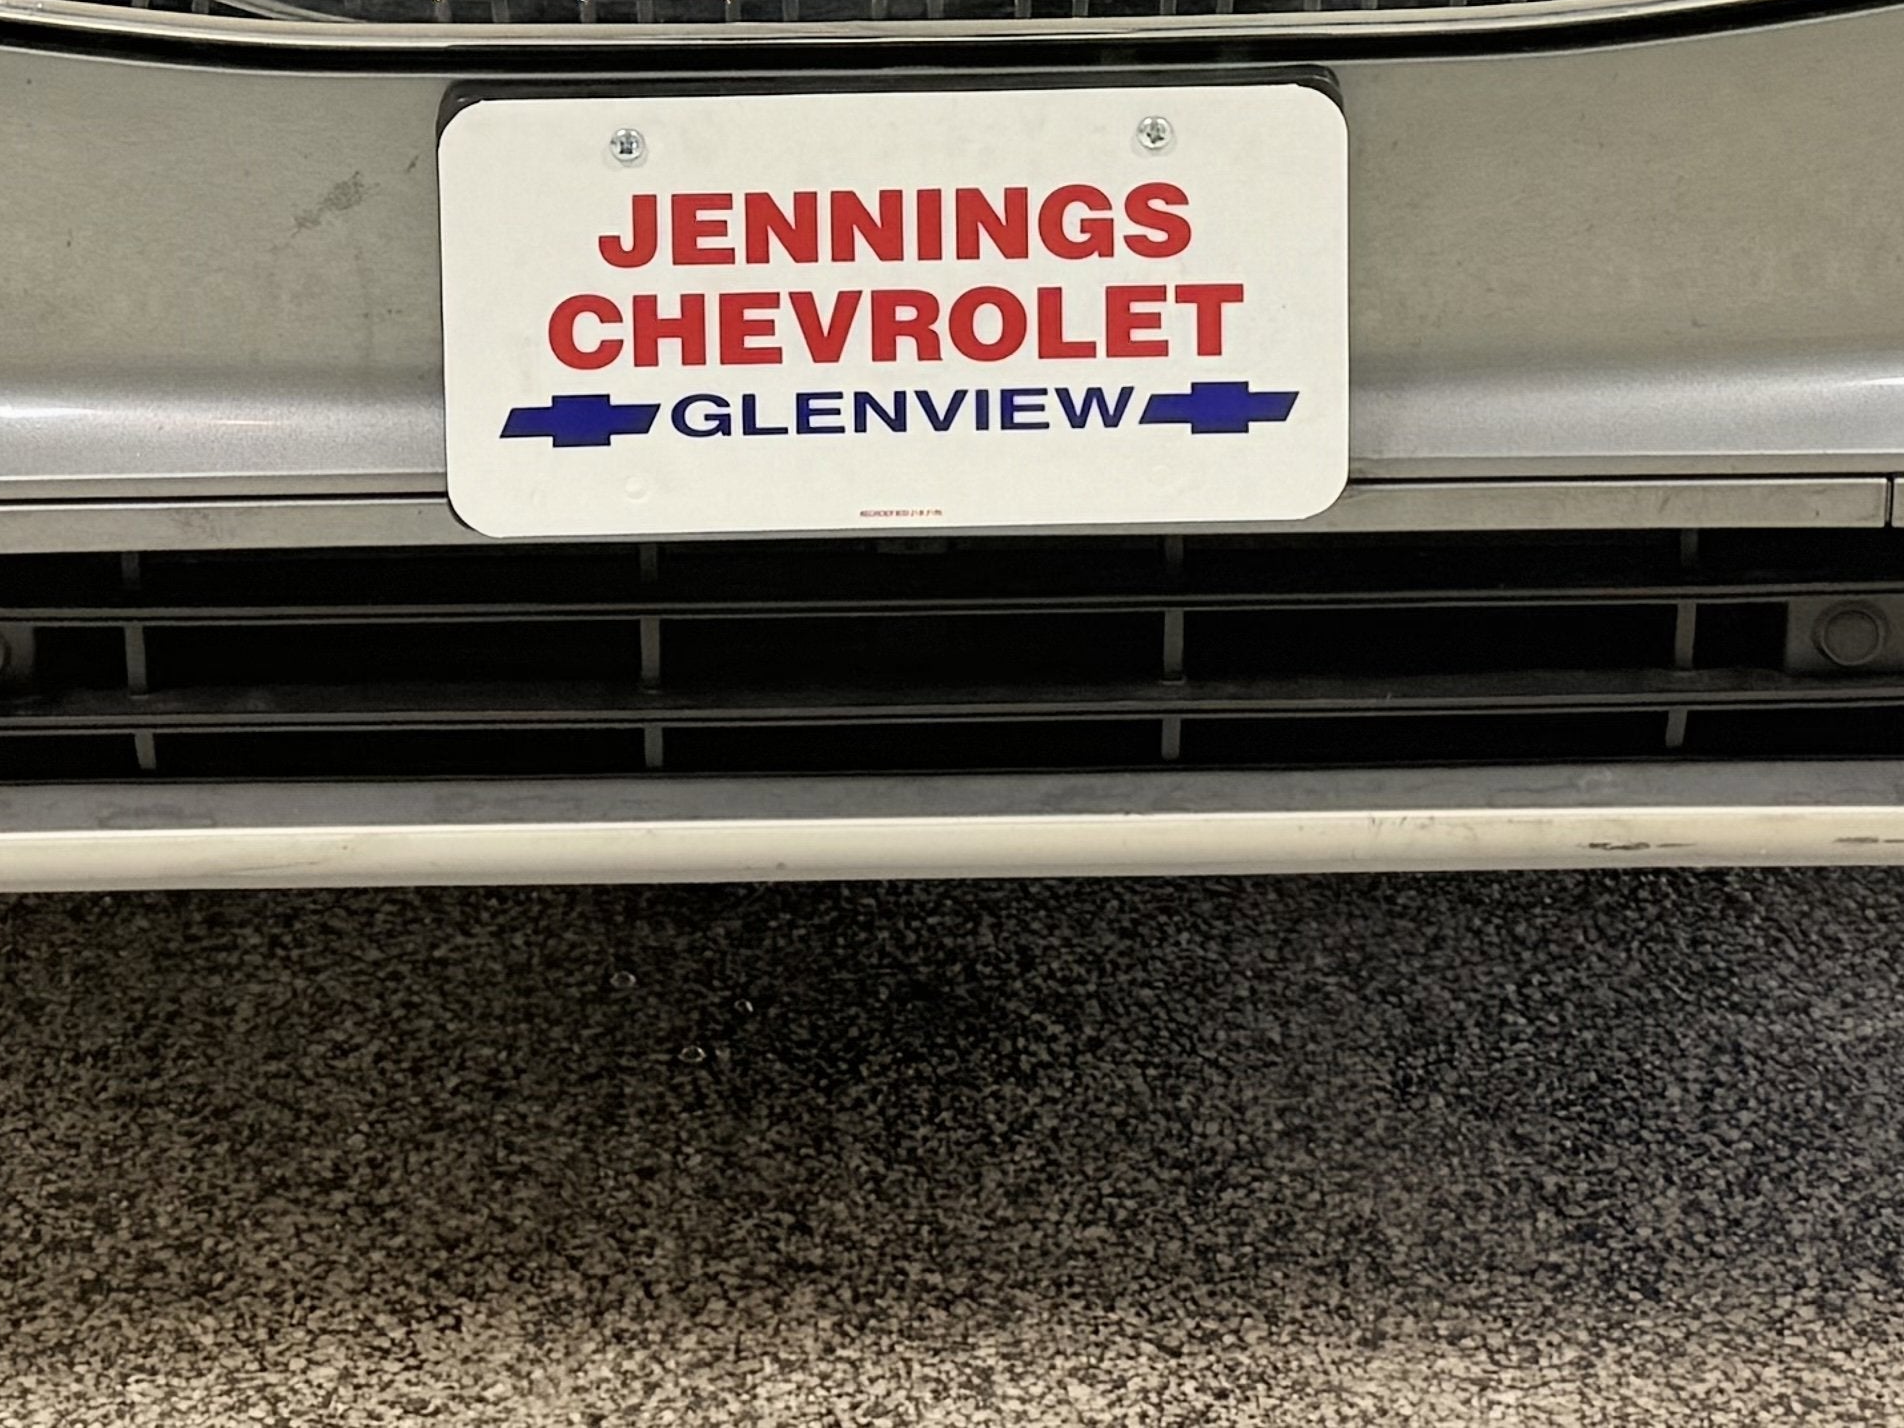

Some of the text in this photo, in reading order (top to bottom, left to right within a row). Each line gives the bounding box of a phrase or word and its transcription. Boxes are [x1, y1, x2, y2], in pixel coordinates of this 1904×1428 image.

[599, 183, 1192, 269] JENNINGS
[548, 284, 1245, 371] CHEVROLET
[670, 386, 1135, 438] GLENVIEW
